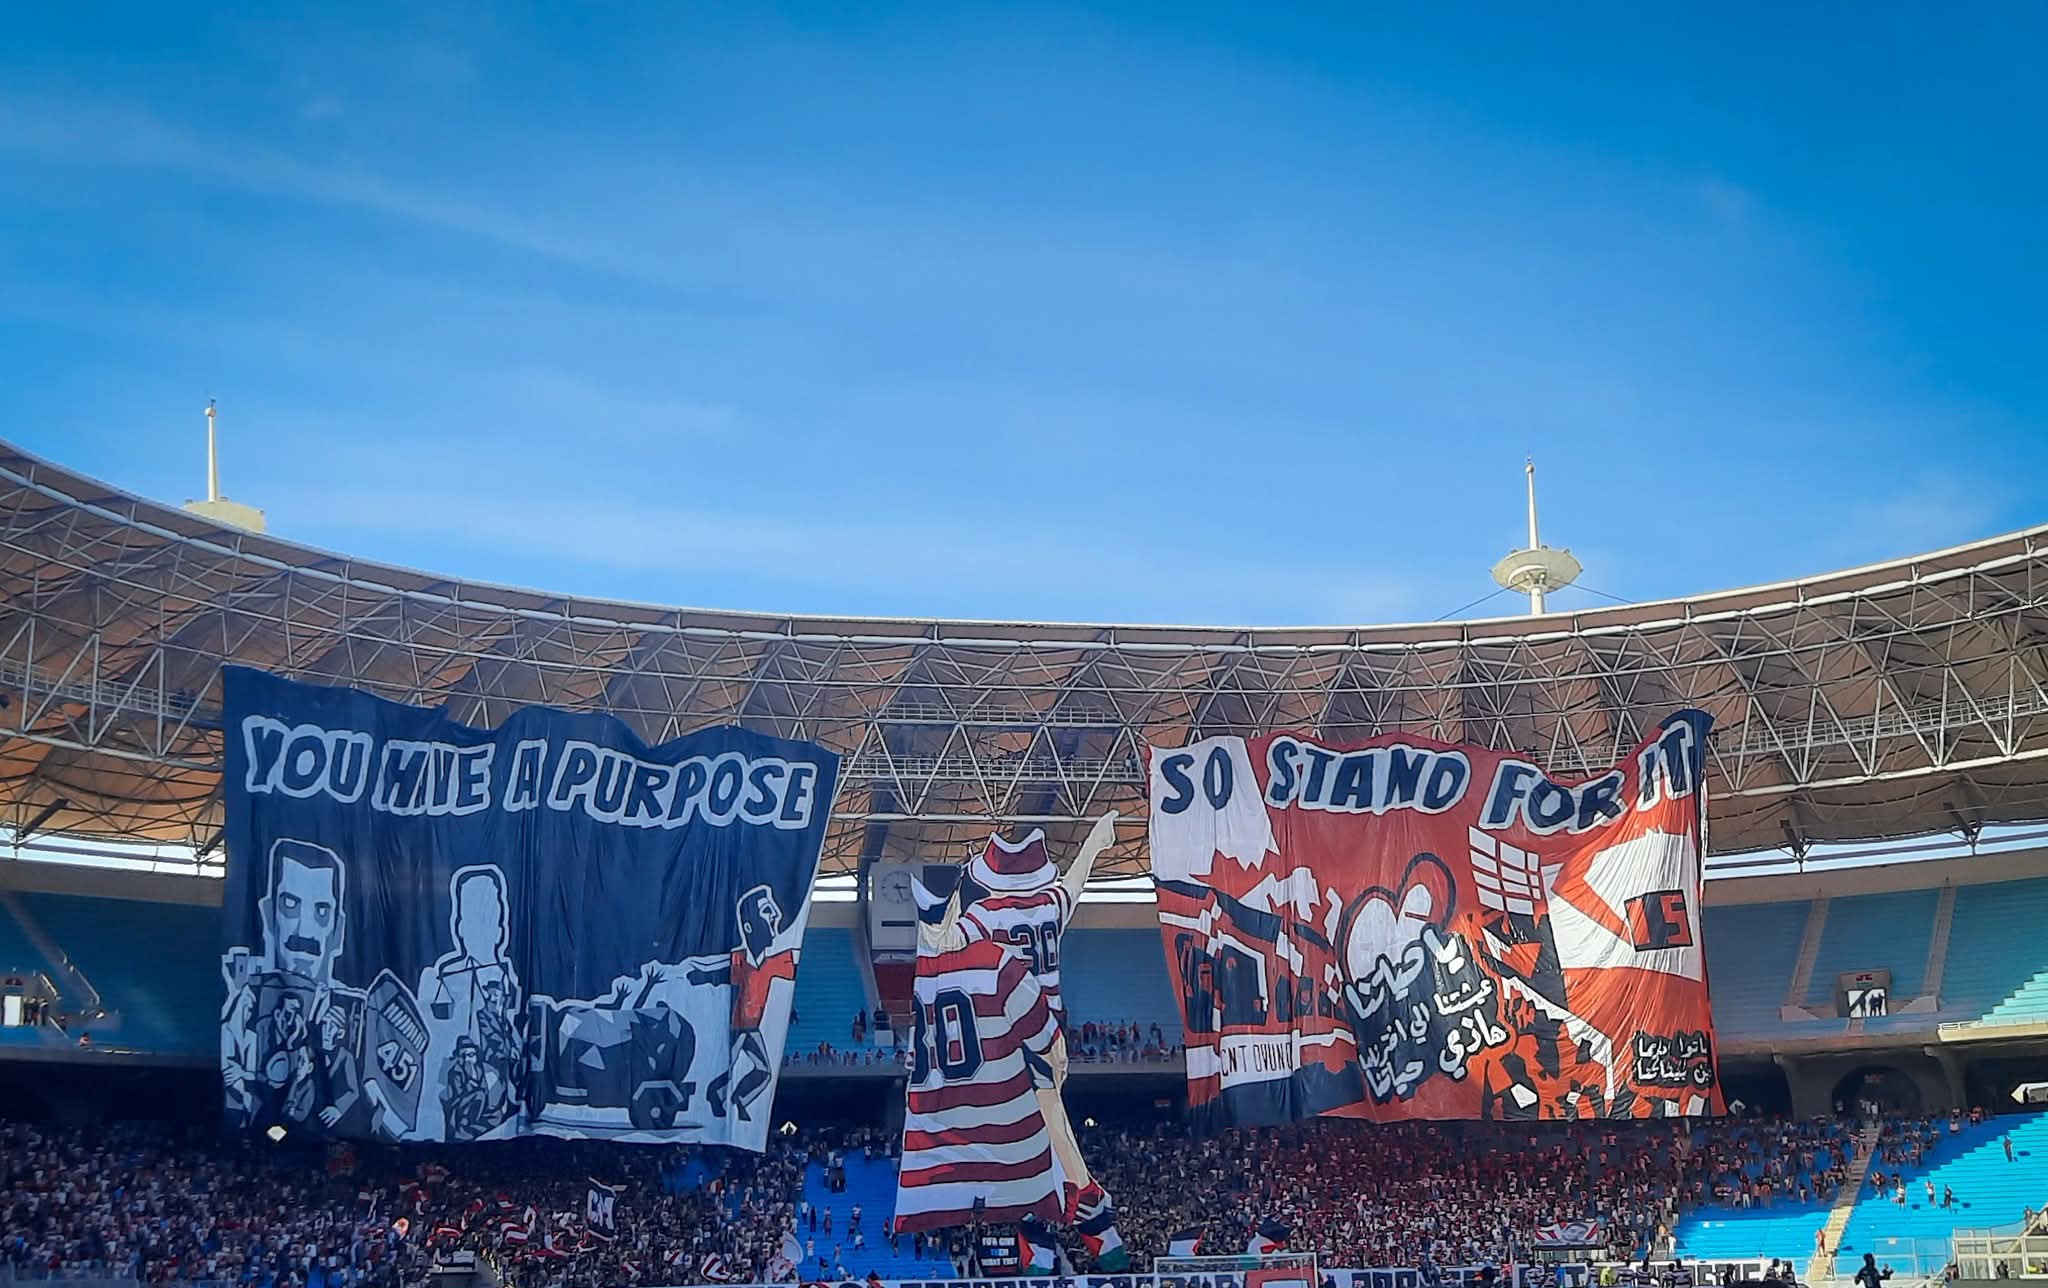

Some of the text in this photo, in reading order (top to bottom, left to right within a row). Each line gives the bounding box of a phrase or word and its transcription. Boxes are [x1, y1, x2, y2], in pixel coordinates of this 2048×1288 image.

[243, 716, 818, 830] YOU HVE A PURPOSE
[1160, 720, 1694, 835] SO STAND FOR IT
[1009, 921, 1058, 978] 30
[377, 1040, 418, 1093] 451
[1365, 1059, 1425, 1099] حياتنا
